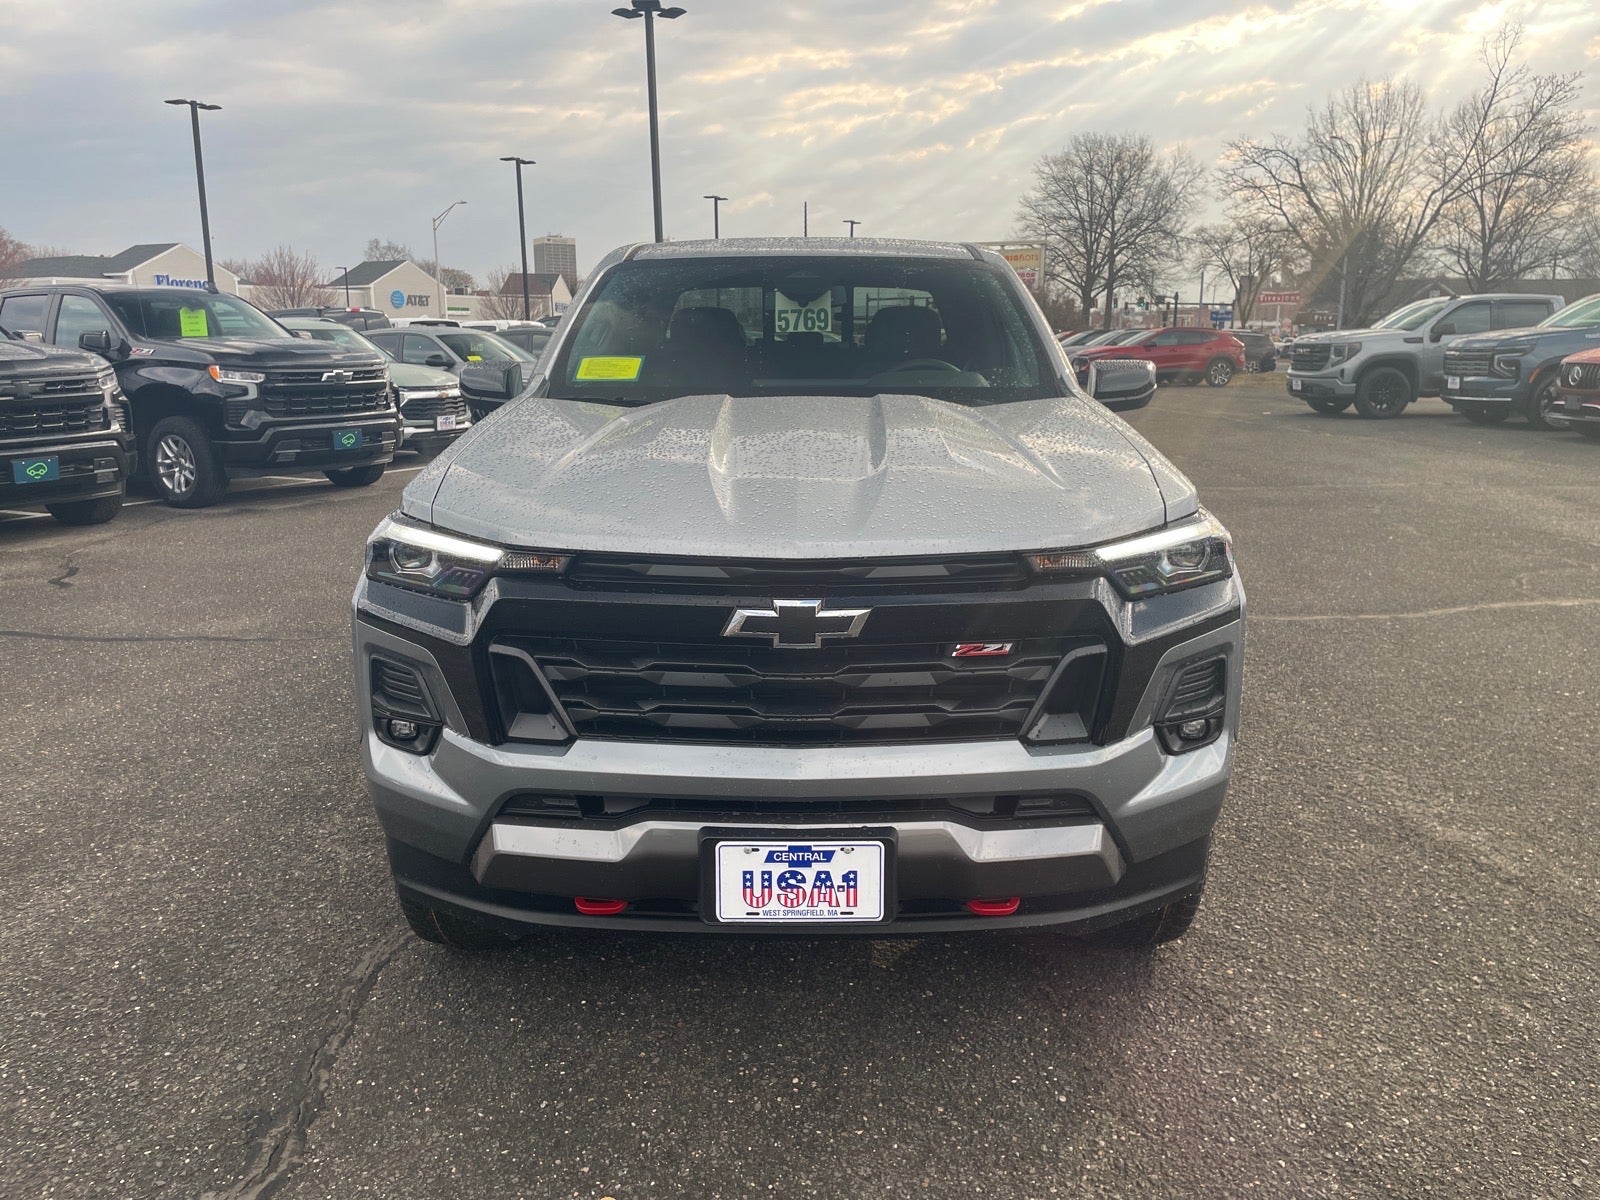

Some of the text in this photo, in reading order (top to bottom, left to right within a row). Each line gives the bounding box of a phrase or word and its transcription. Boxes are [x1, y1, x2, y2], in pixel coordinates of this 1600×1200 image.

[406, 294, 430, 307] AT&T
[776, 307, 829, 332] 5769
[951, 642, 1013, 657] Z71
[773, 852, 827, 862] CENTRAL
[742, 869, 858, 908] USA-1
[762, 909, 781, 917] WEST
[828, 909, 839, 917] MA
